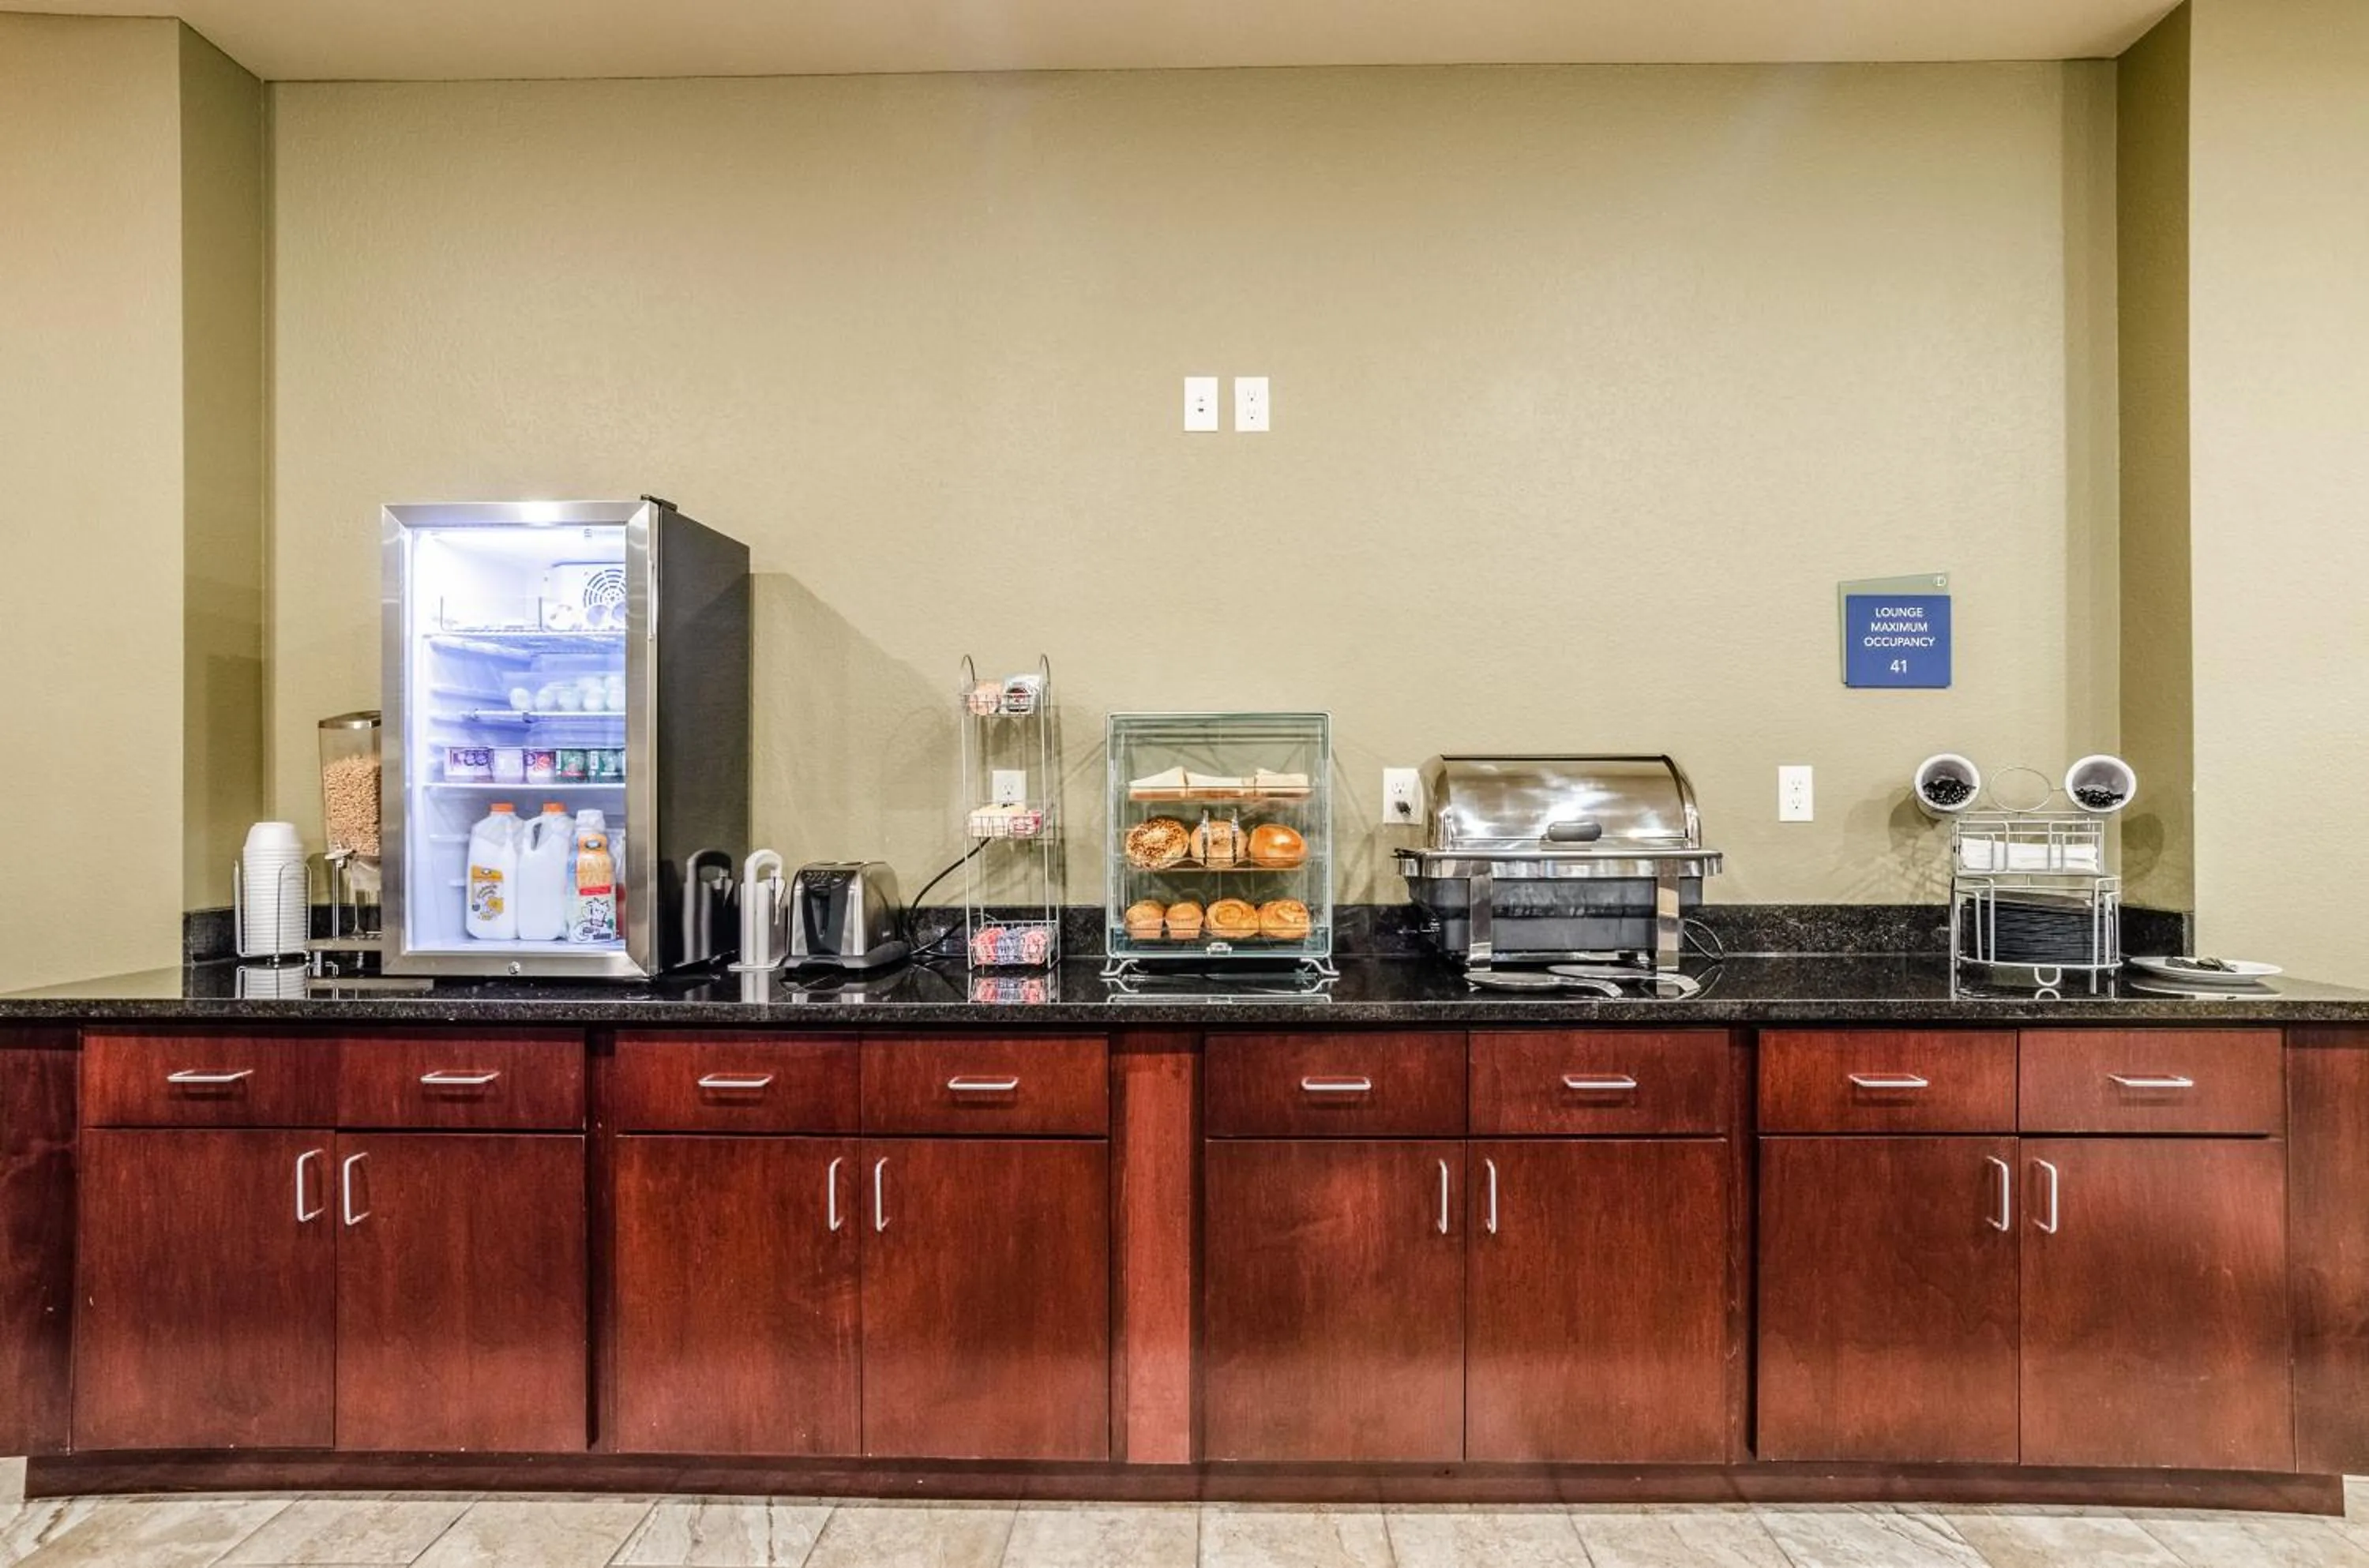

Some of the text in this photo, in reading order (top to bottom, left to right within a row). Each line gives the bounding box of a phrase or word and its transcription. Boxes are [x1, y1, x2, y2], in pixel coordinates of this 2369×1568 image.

[1875, 607, 1924, 617] LOUNGE
[1871, 622, 1928, 632] MAXIMUM
[1864, 637, 1935, 647] OCCUPANCY
[1890, 659, 1907, 673] 41
